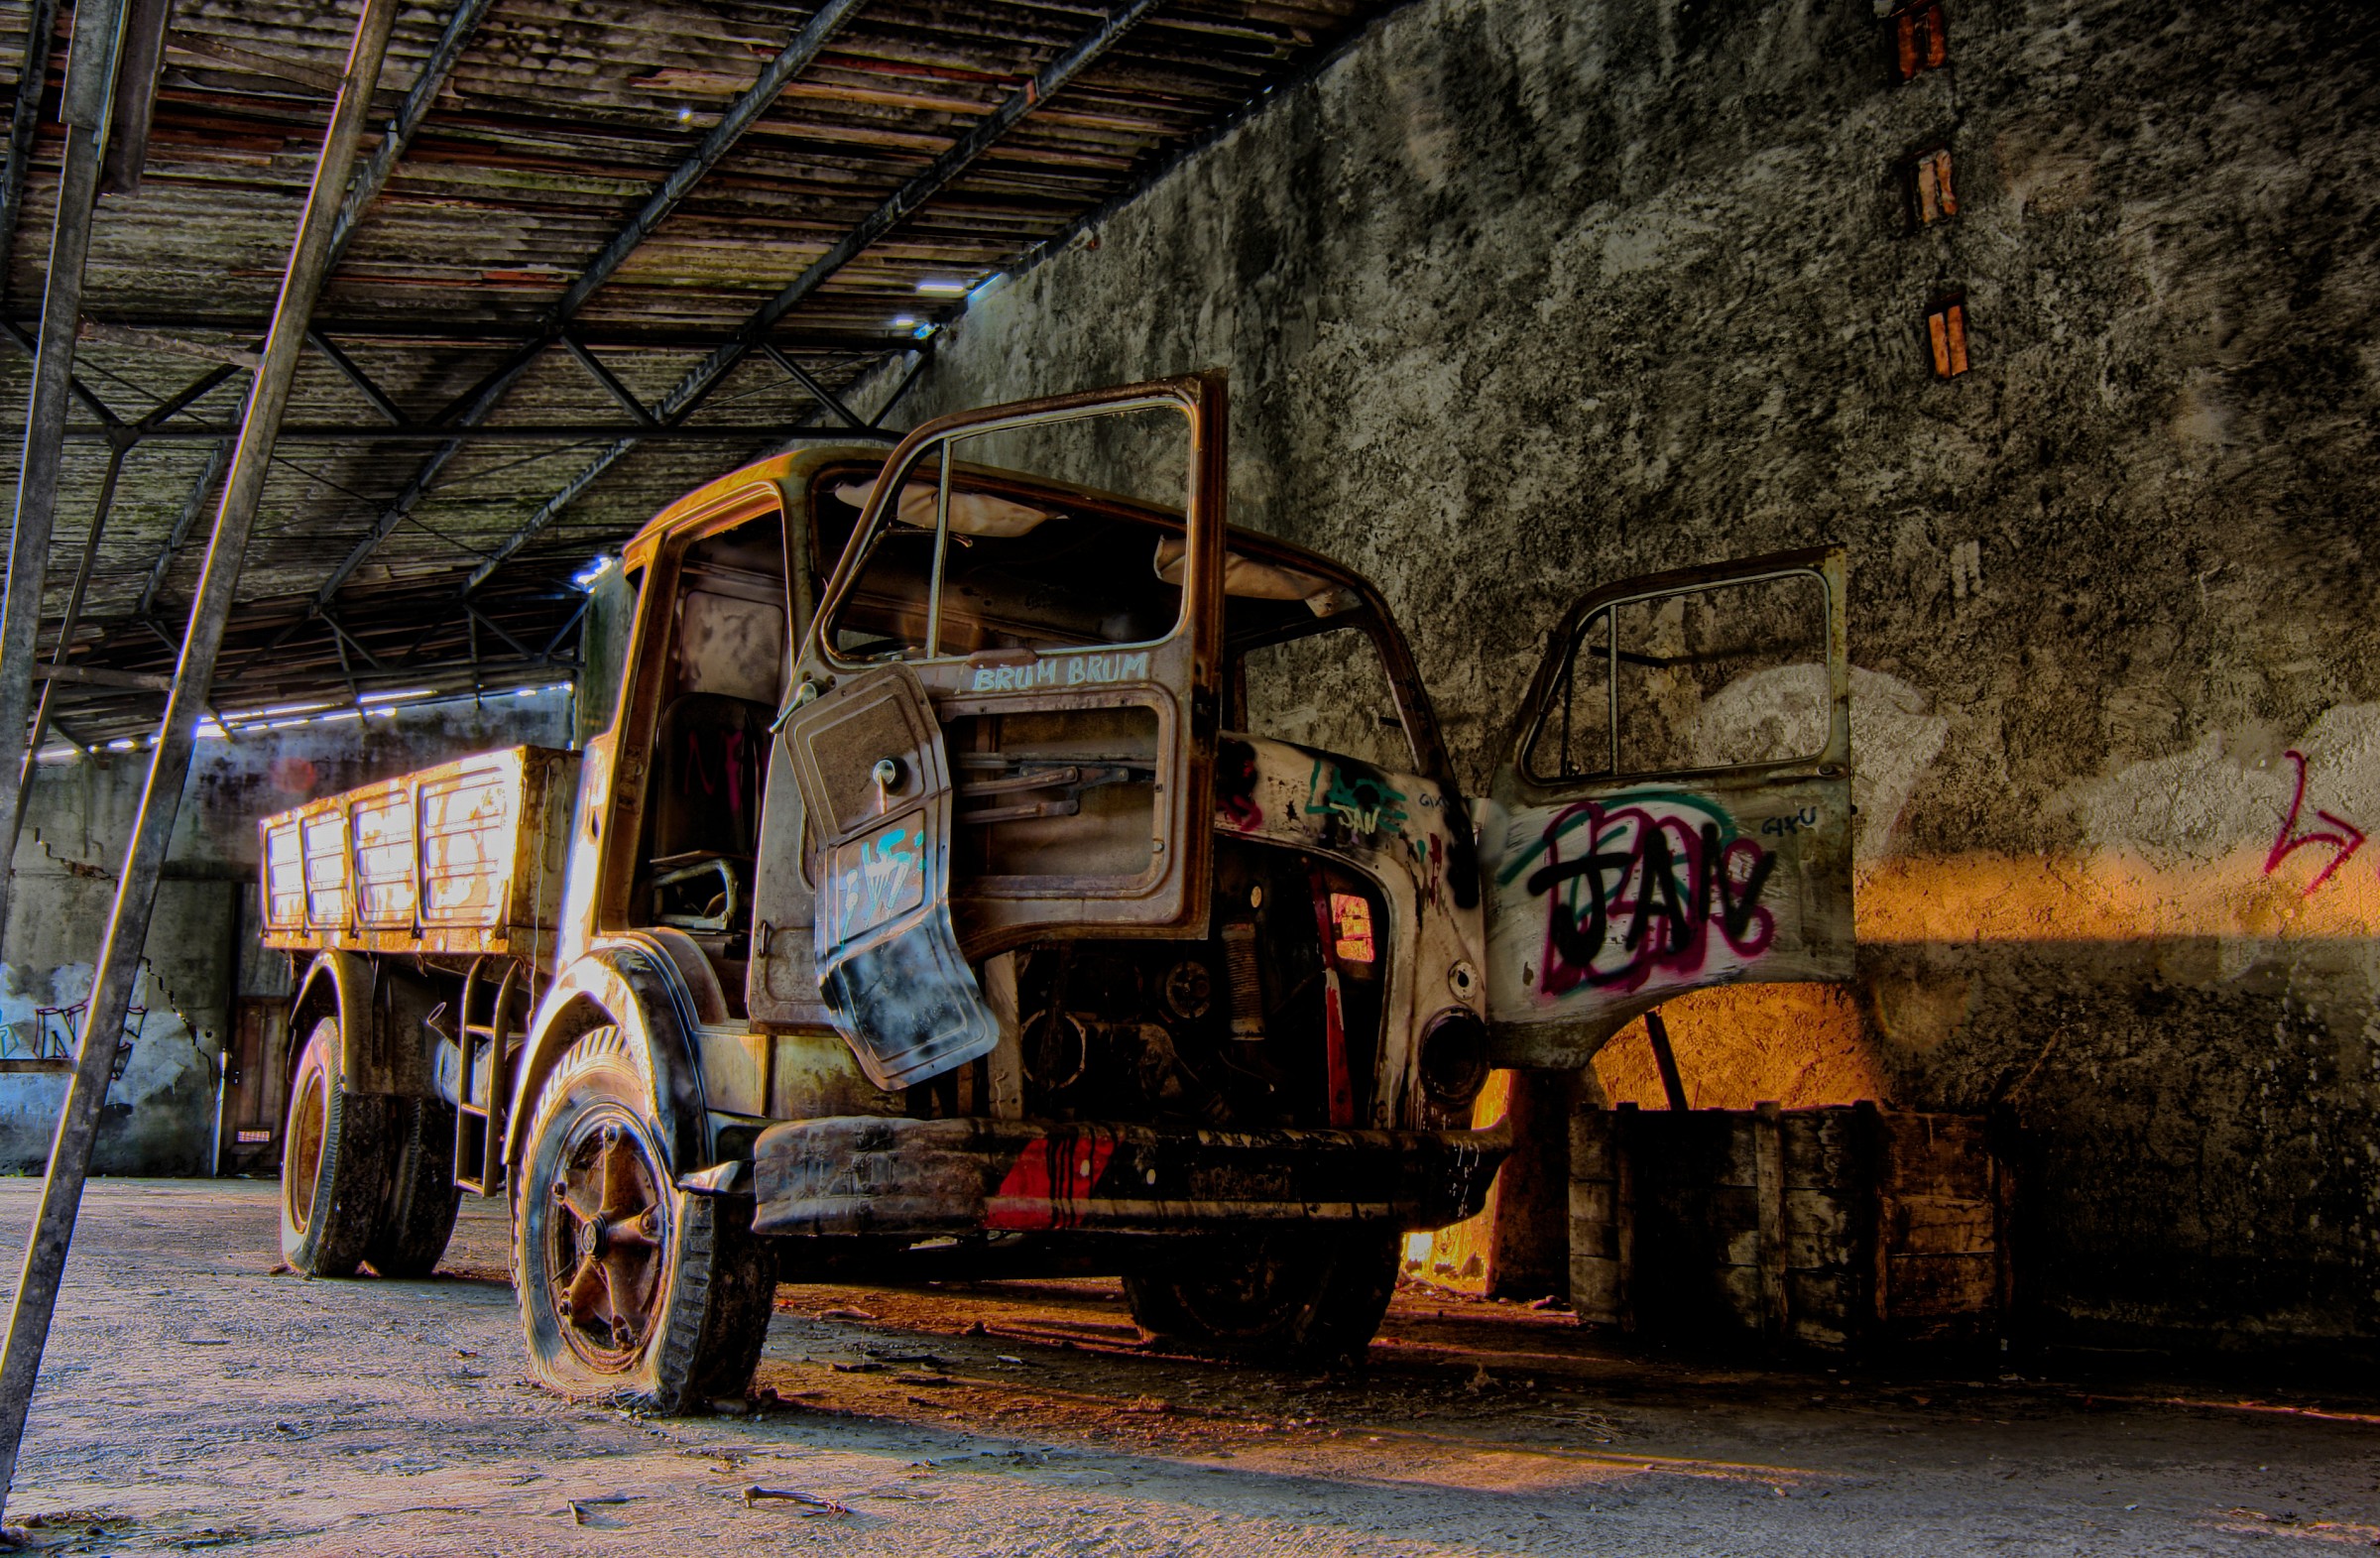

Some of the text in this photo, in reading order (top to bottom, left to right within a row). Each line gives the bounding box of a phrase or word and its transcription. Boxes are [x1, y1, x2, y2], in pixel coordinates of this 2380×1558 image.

[973, 652, 1148, 691] BRUM BRUM
[1528, 822, 1776, 966] JAN
